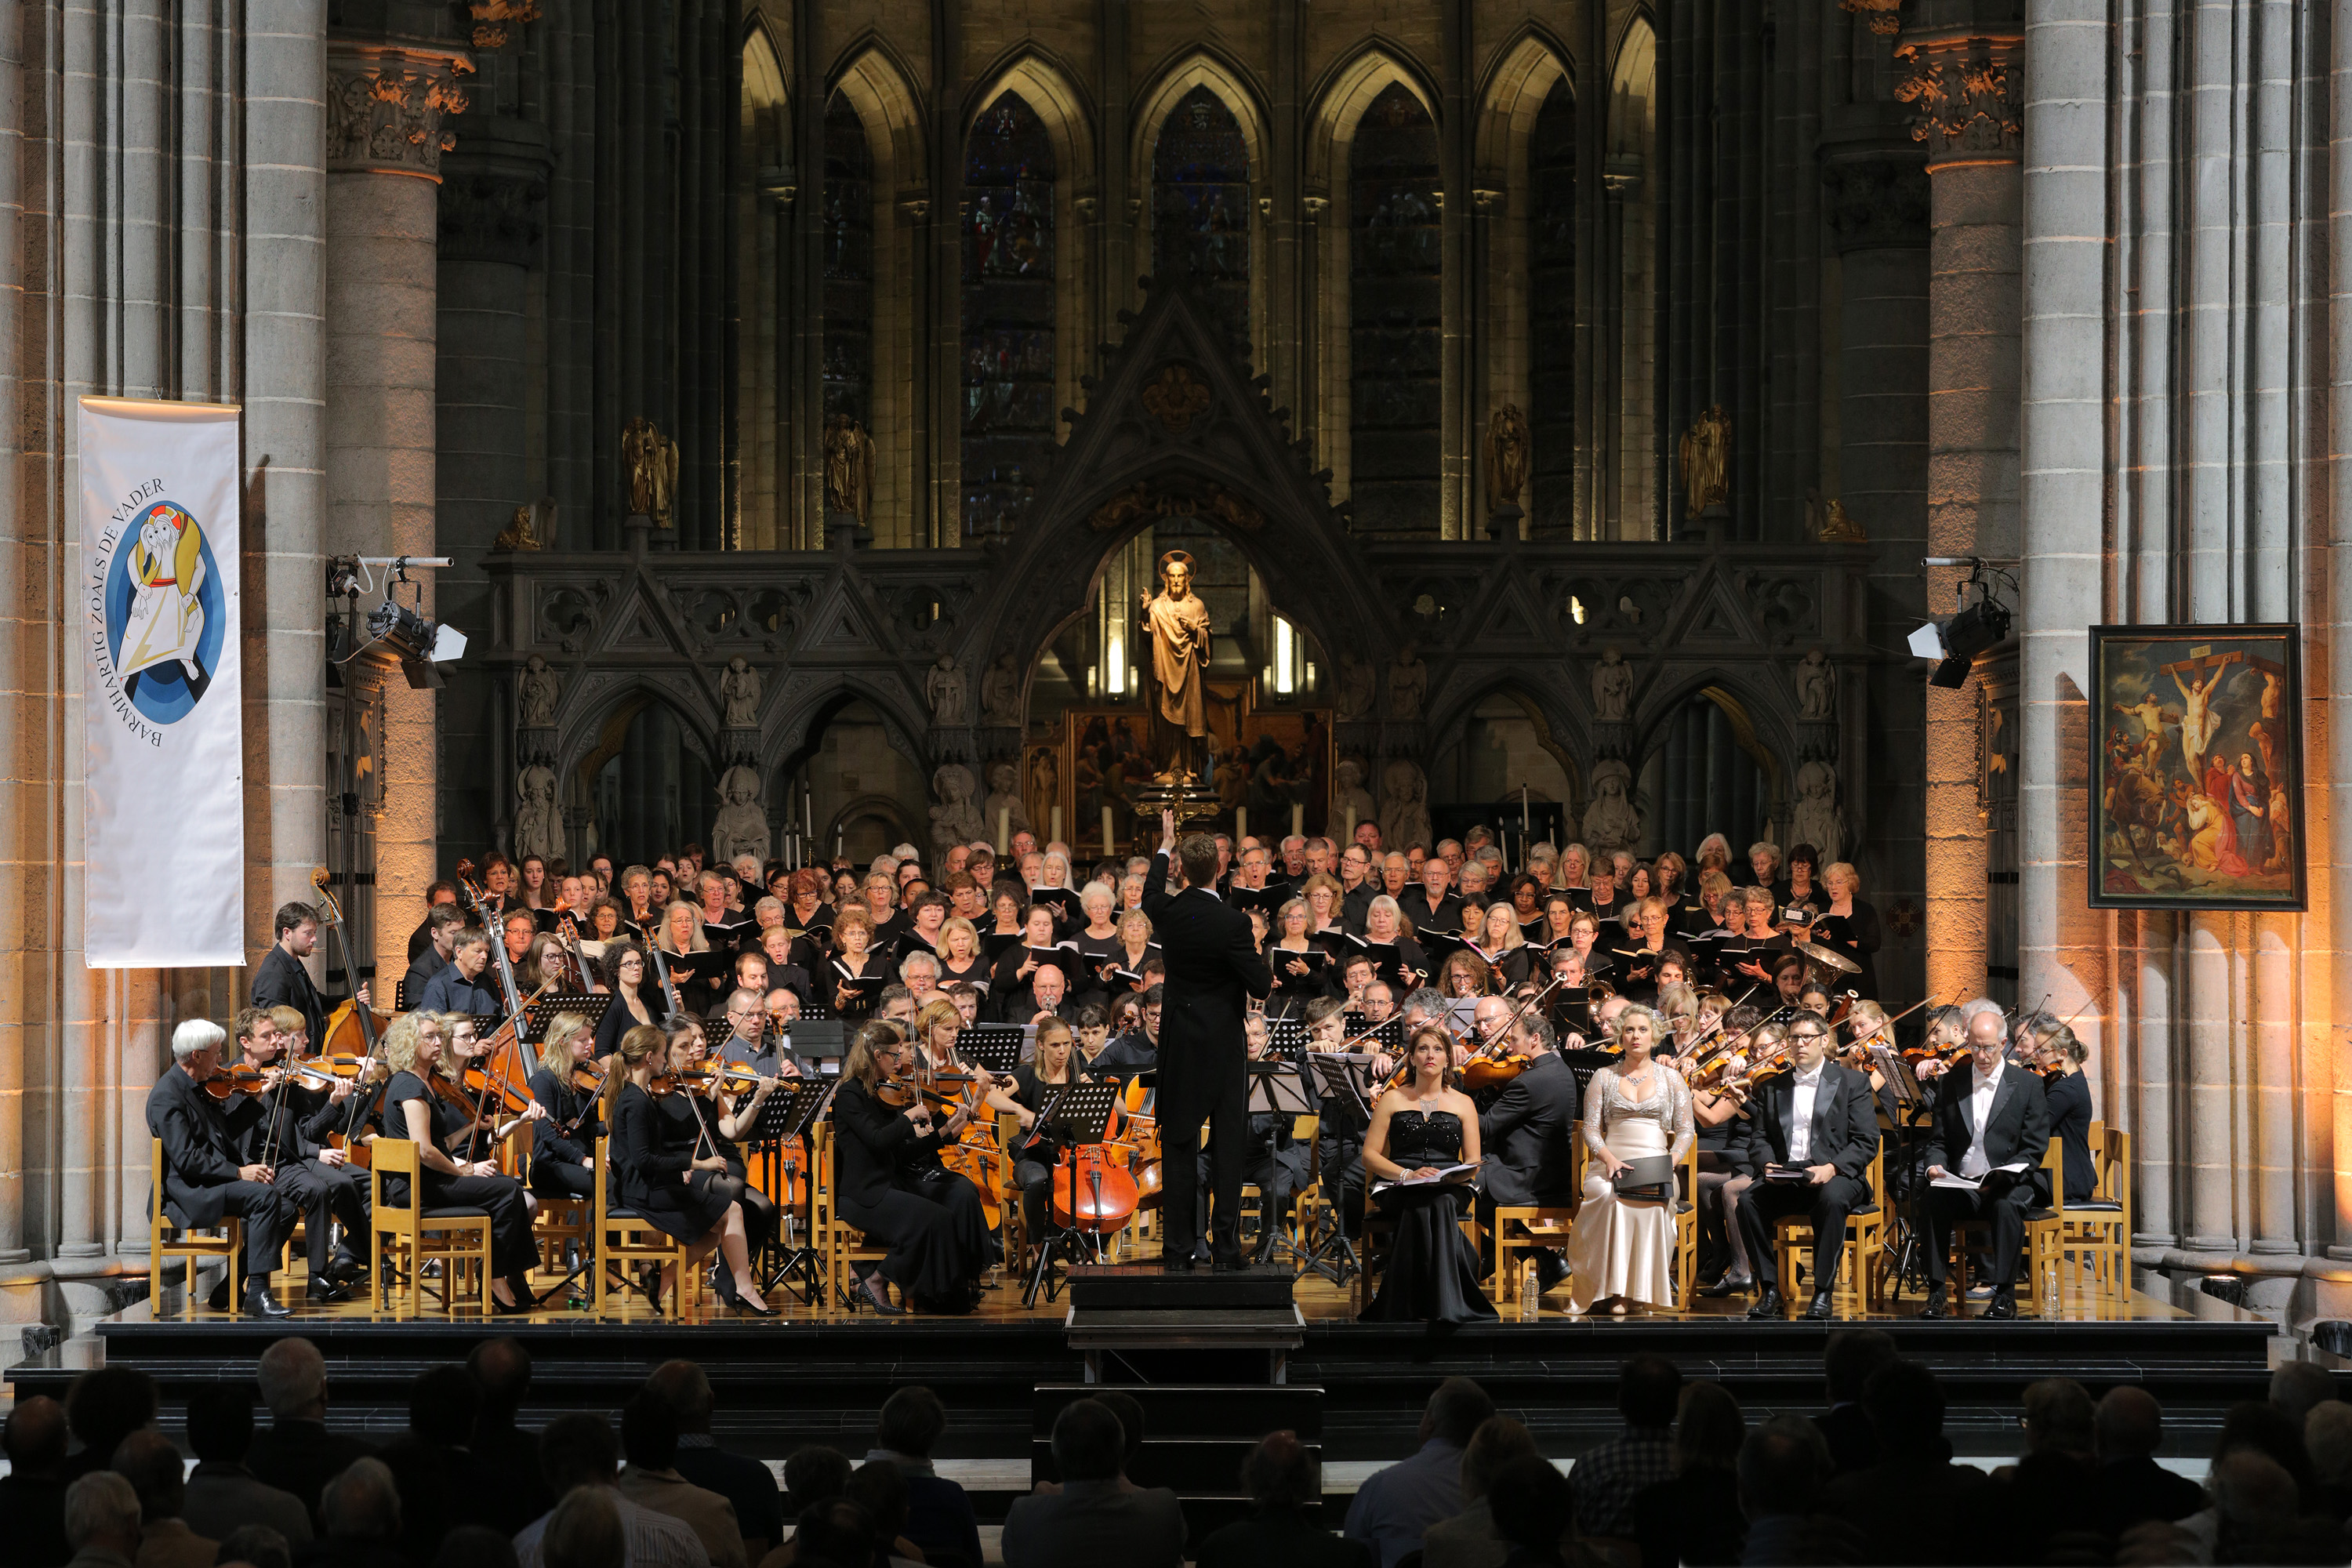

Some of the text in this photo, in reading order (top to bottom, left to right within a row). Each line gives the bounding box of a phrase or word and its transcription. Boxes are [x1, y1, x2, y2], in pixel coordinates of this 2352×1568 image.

[92, 477, 165, 747] BARMHARTIG ZOALS DE VADER
